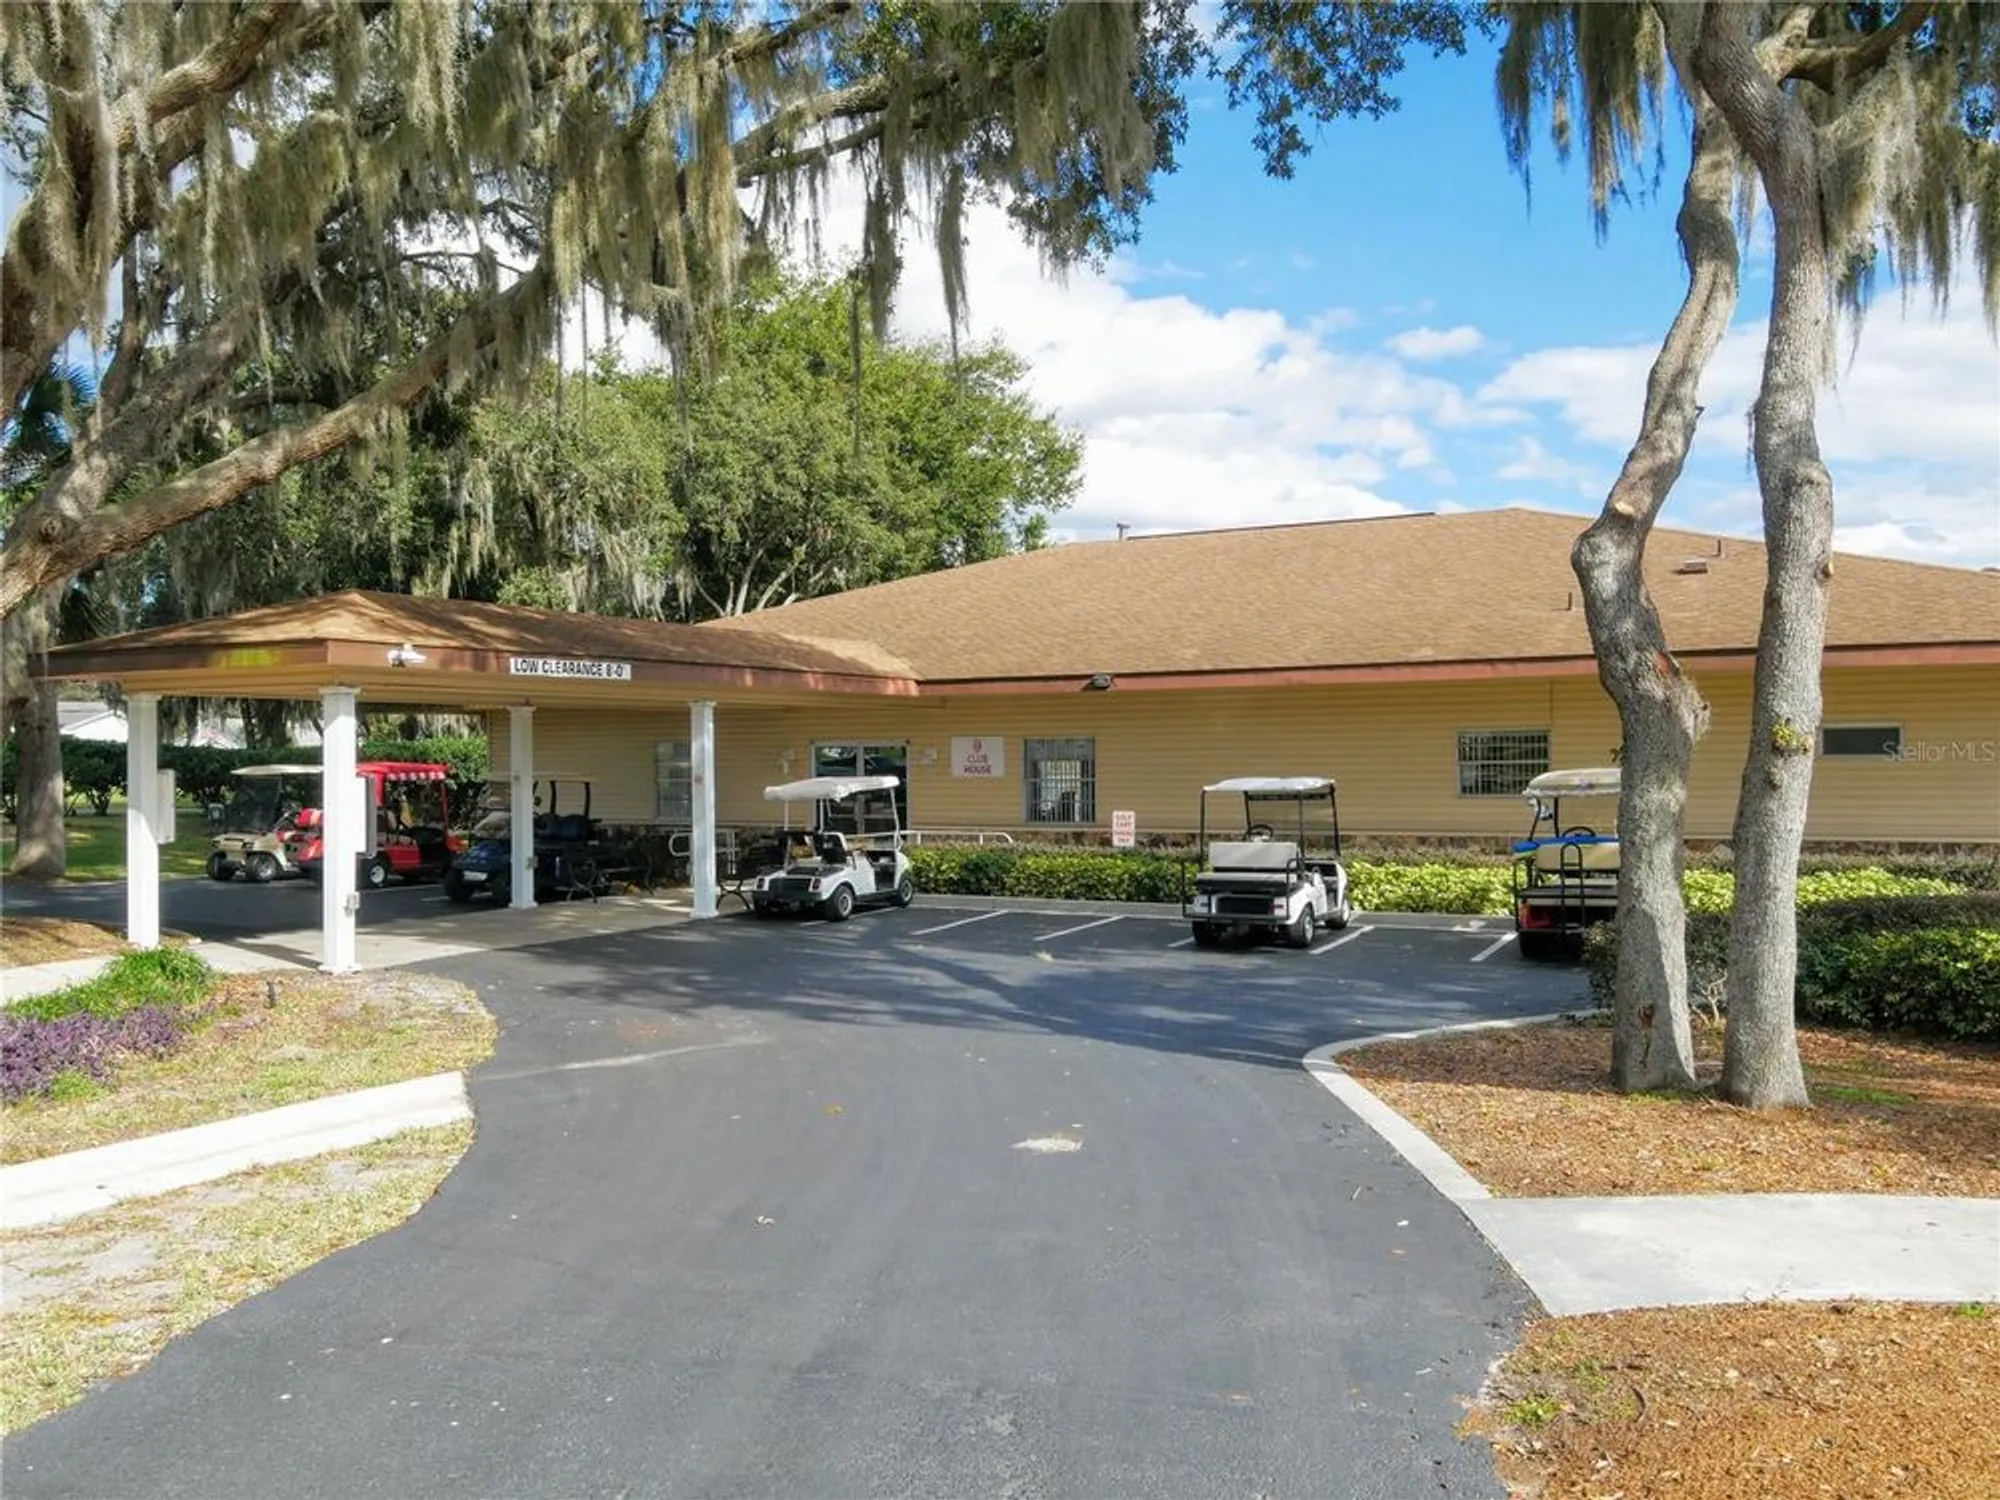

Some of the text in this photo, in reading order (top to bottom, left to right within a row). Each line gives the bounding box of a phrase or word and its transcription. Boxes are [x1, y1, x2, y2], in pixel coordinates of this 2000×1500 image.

[513, 659, 539, 673] LOW
[541, 660, 603, 676] CLEARANCE
[966, 754, 988, 763] CLUB
[963, 764, 992, 775] HOUSE
